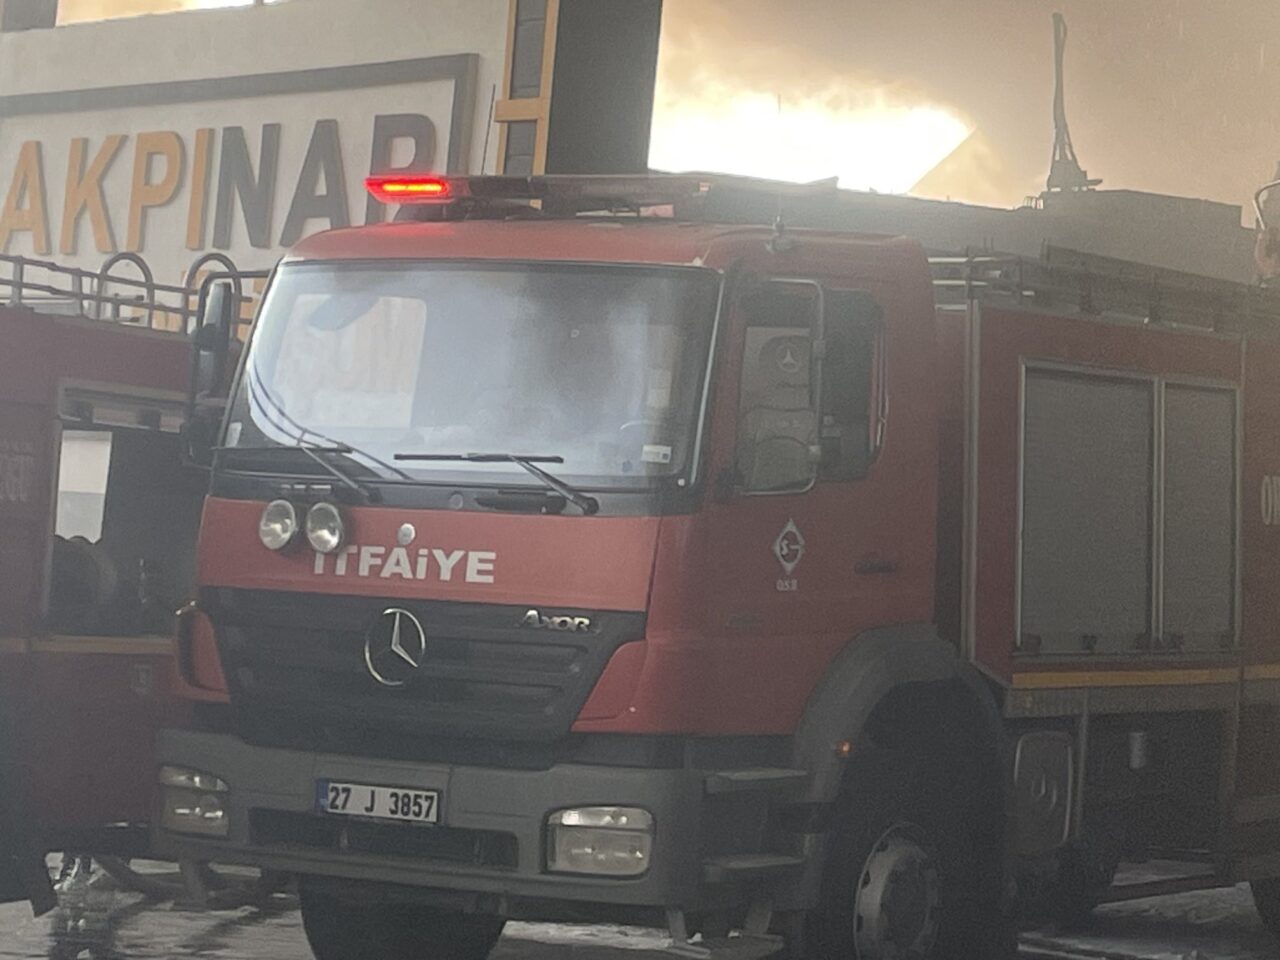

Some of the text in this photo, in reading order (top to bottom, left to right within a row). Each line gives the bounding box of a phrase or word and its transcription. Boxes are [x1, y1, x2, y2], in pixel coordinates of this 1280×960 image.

[329, 786, 435, 819] 27 J 3857
